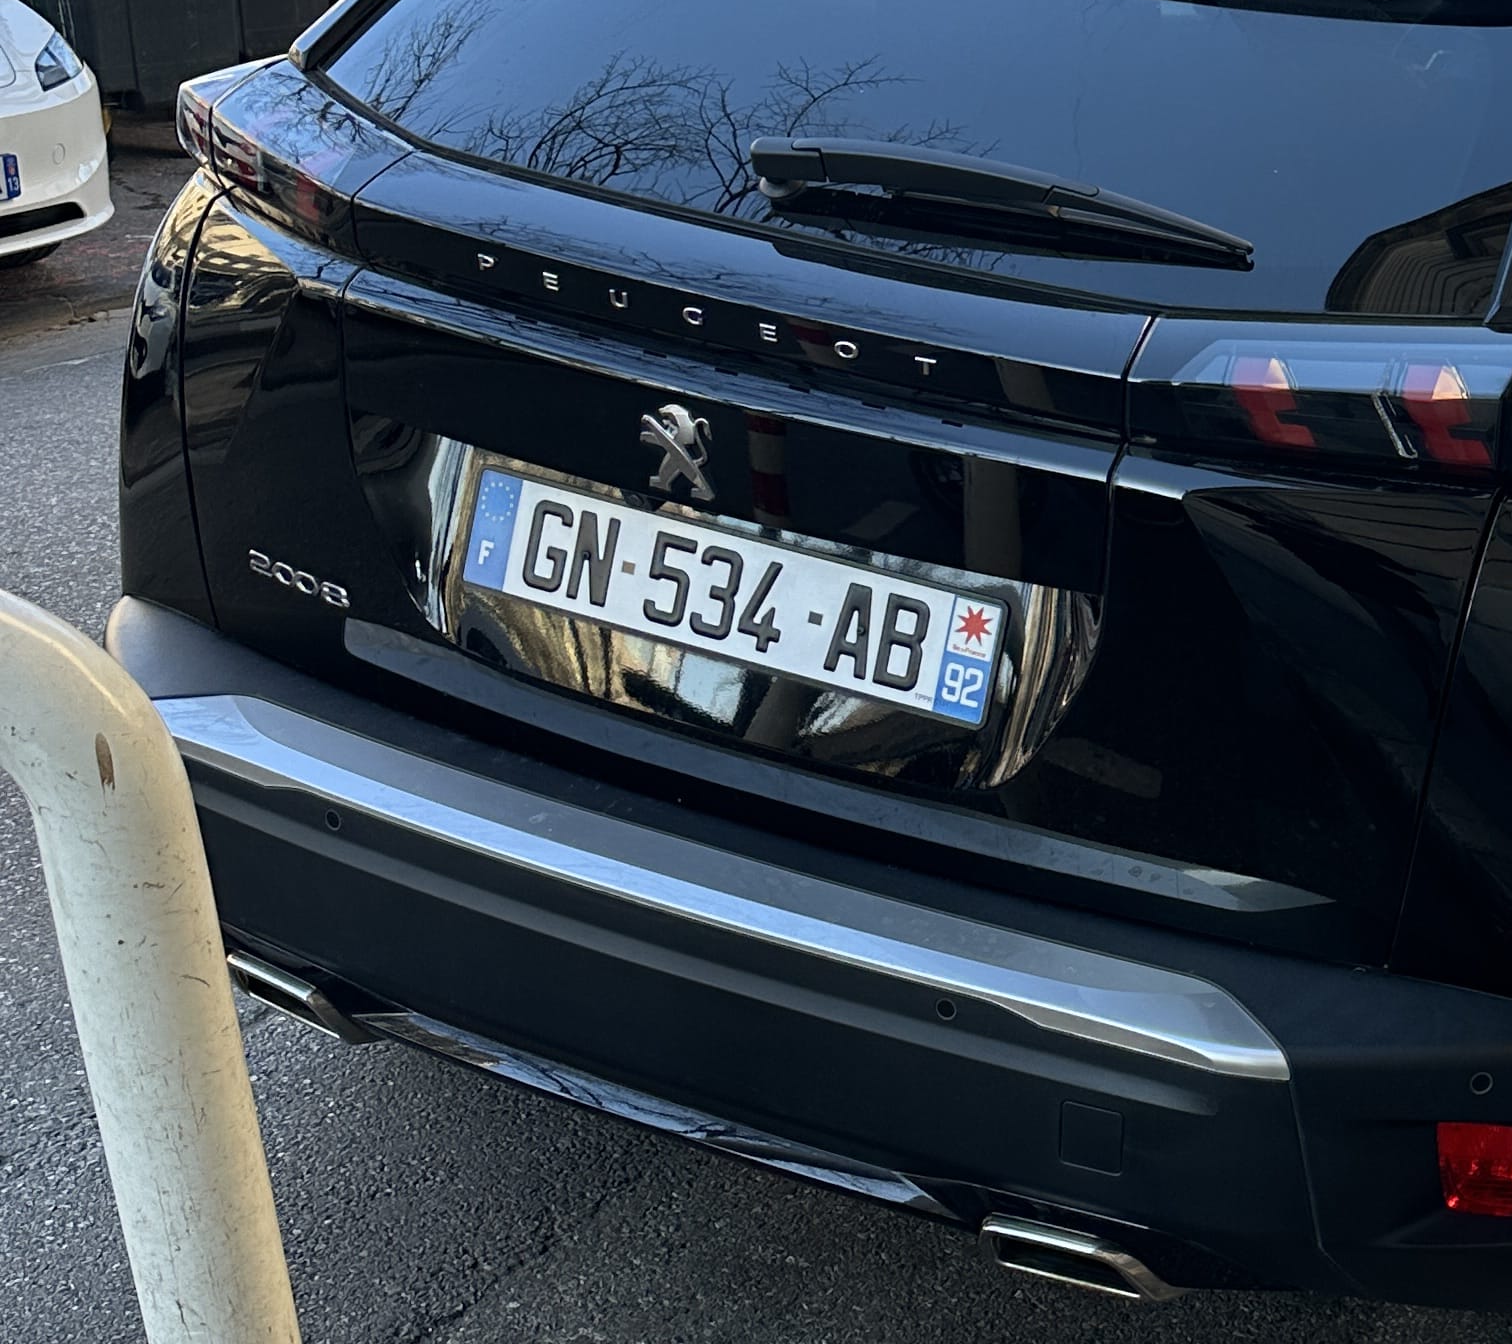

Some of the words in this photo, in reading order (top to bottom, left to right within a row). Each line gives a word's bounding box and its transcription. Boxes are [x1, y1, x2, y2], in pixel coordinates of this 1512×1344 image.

[7, 176, 20, 192] 13
[476, 252, 938, 376] PEUGEOT
[248, 548, 351, 608] 2008
[477, 539, 495, 566] F
[521, 499, 931, 693] GN-534-AB
[941, 661, 985, 709] 92
